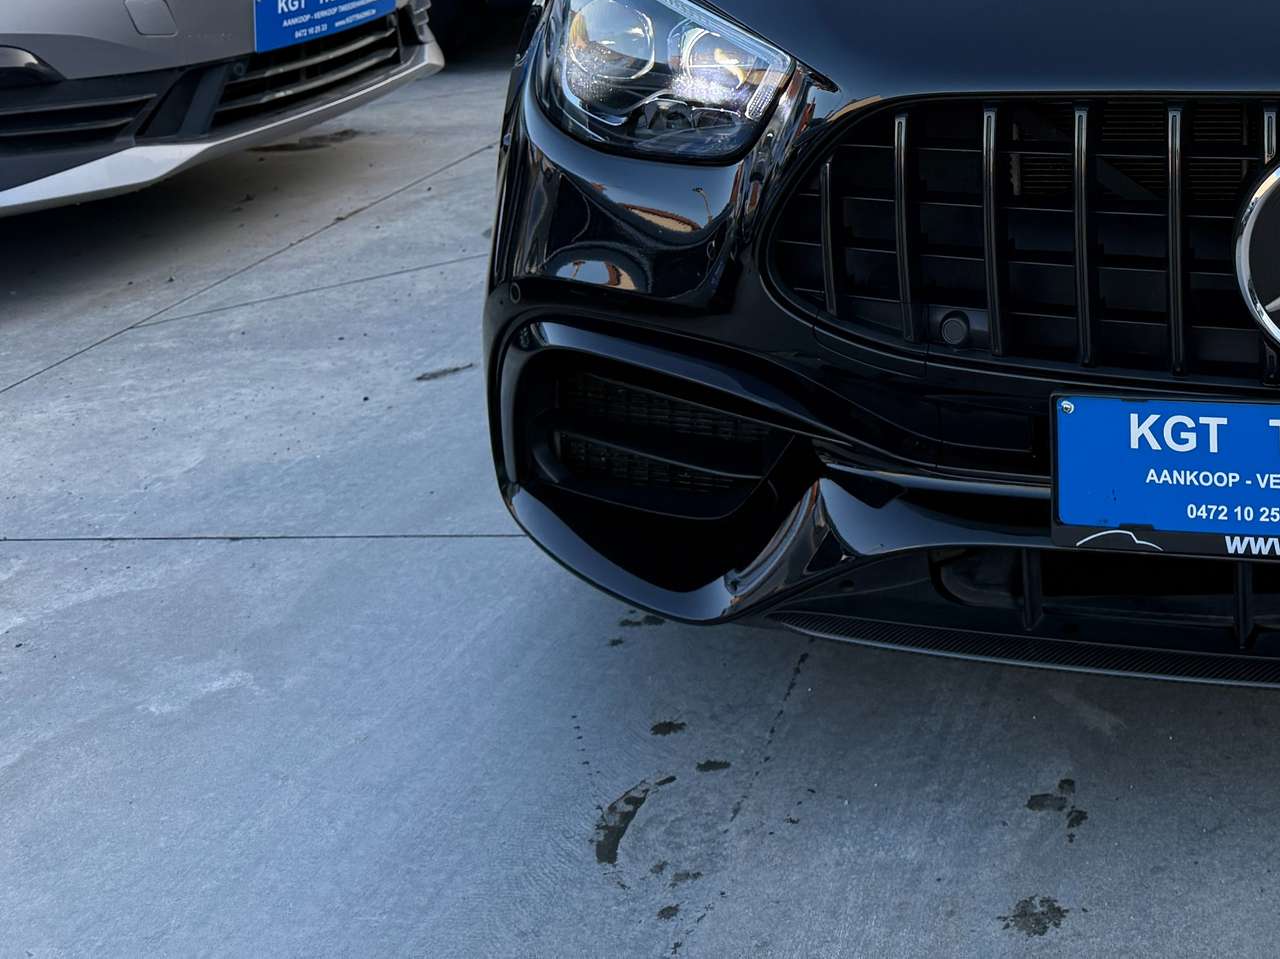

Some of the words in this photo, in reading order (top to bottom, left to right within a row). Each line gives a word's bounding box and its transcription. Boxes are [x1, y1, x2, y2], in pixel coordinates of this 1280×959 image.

[1130, 413, 1228, 453] KGT
[1145, 468, 1240, 488] AANKOOP
[1187, 503, 1228, 521] 0472
[1234, 505, 1255, 522] 10
[1259, 506, 1280, 523] 25
